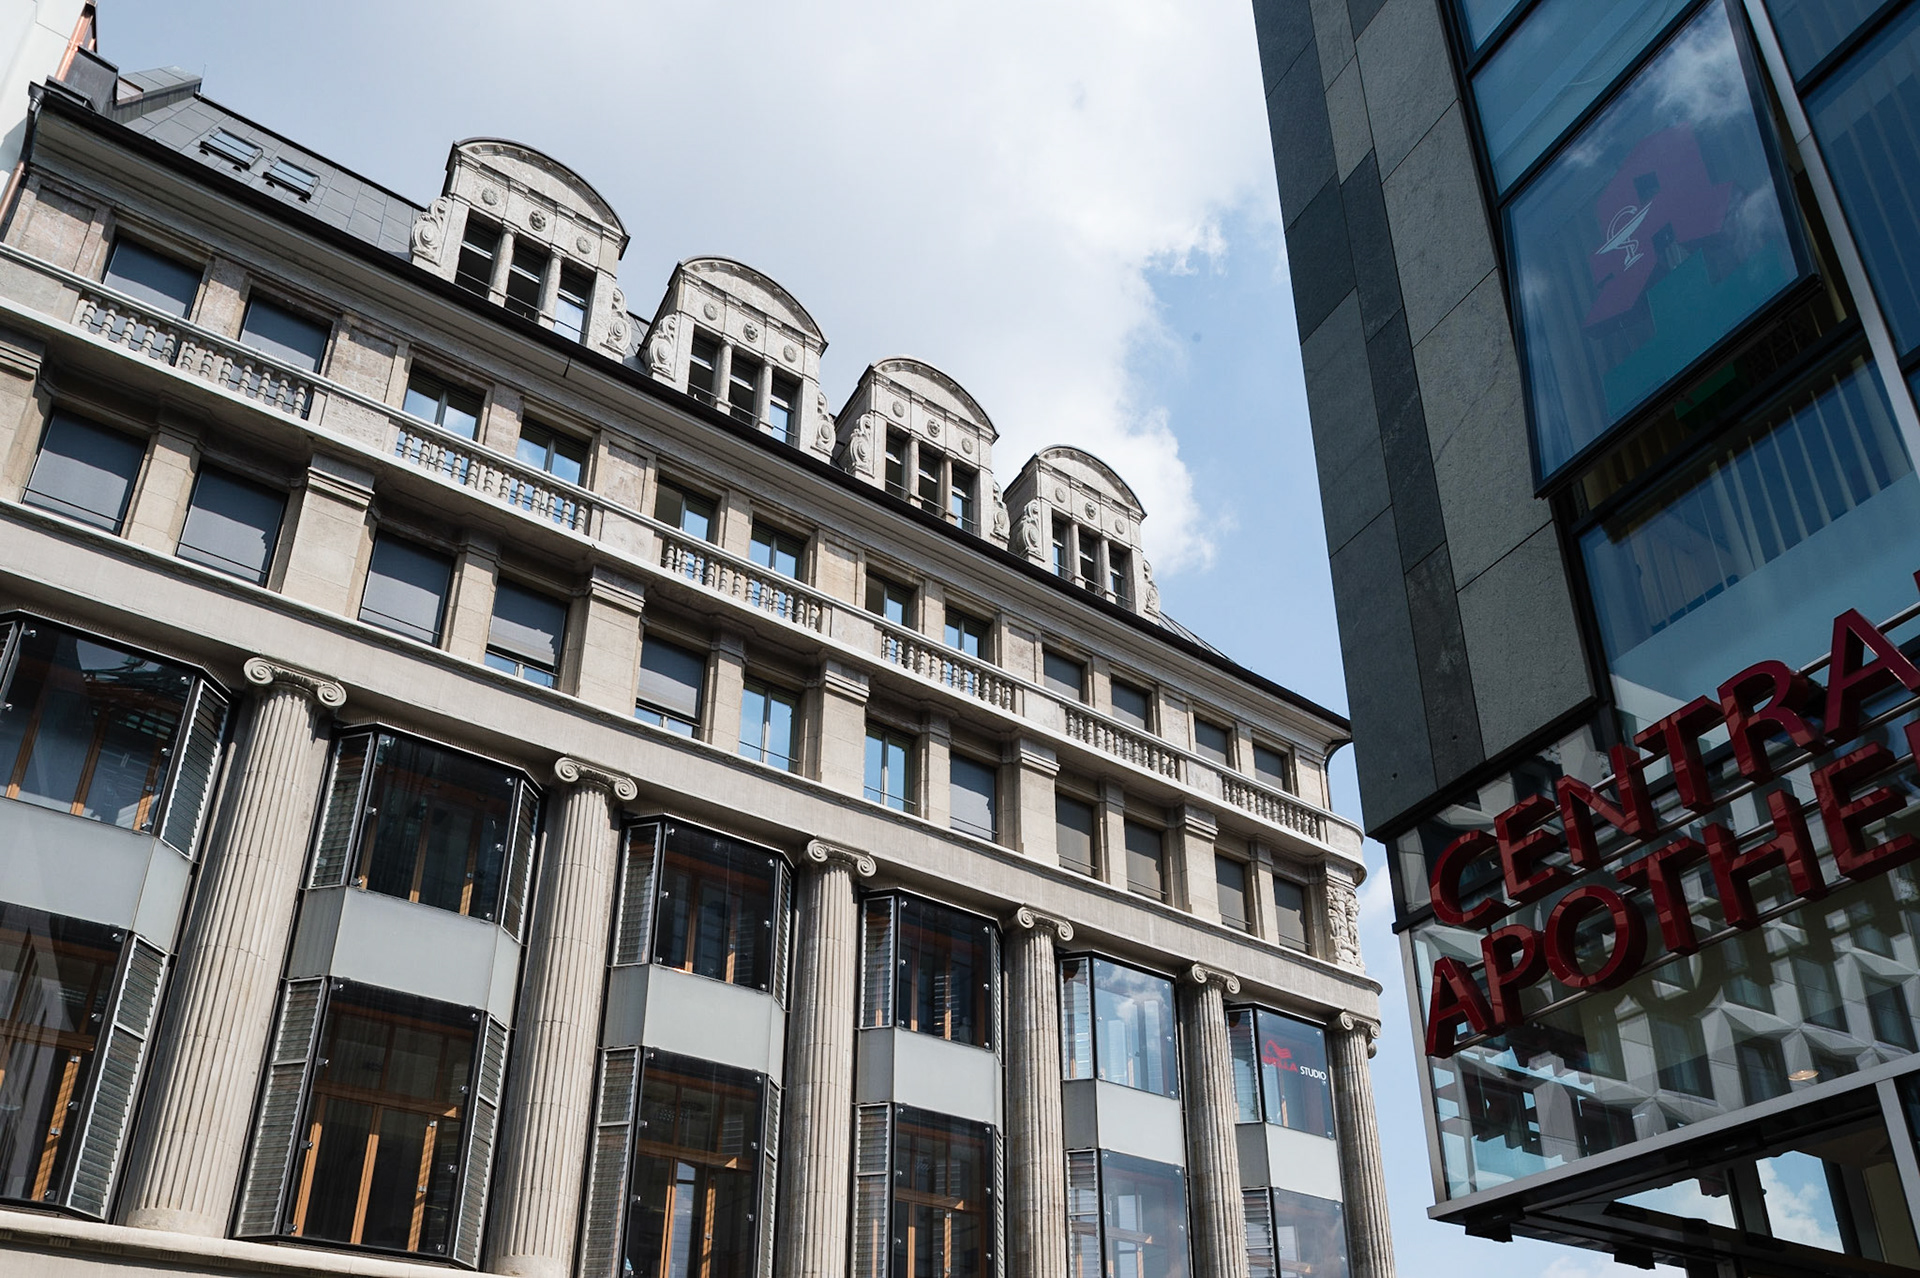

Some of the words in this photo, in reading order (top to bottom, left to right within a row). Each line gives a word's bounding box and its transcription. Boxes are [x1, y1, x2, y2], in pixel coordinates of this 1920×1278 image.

[1425, 720, 1920, 1058] APOTHE
[1430, 570, 1920, 929] CENTRA
[1299, 1065, 1327, 1081] STUDIO
